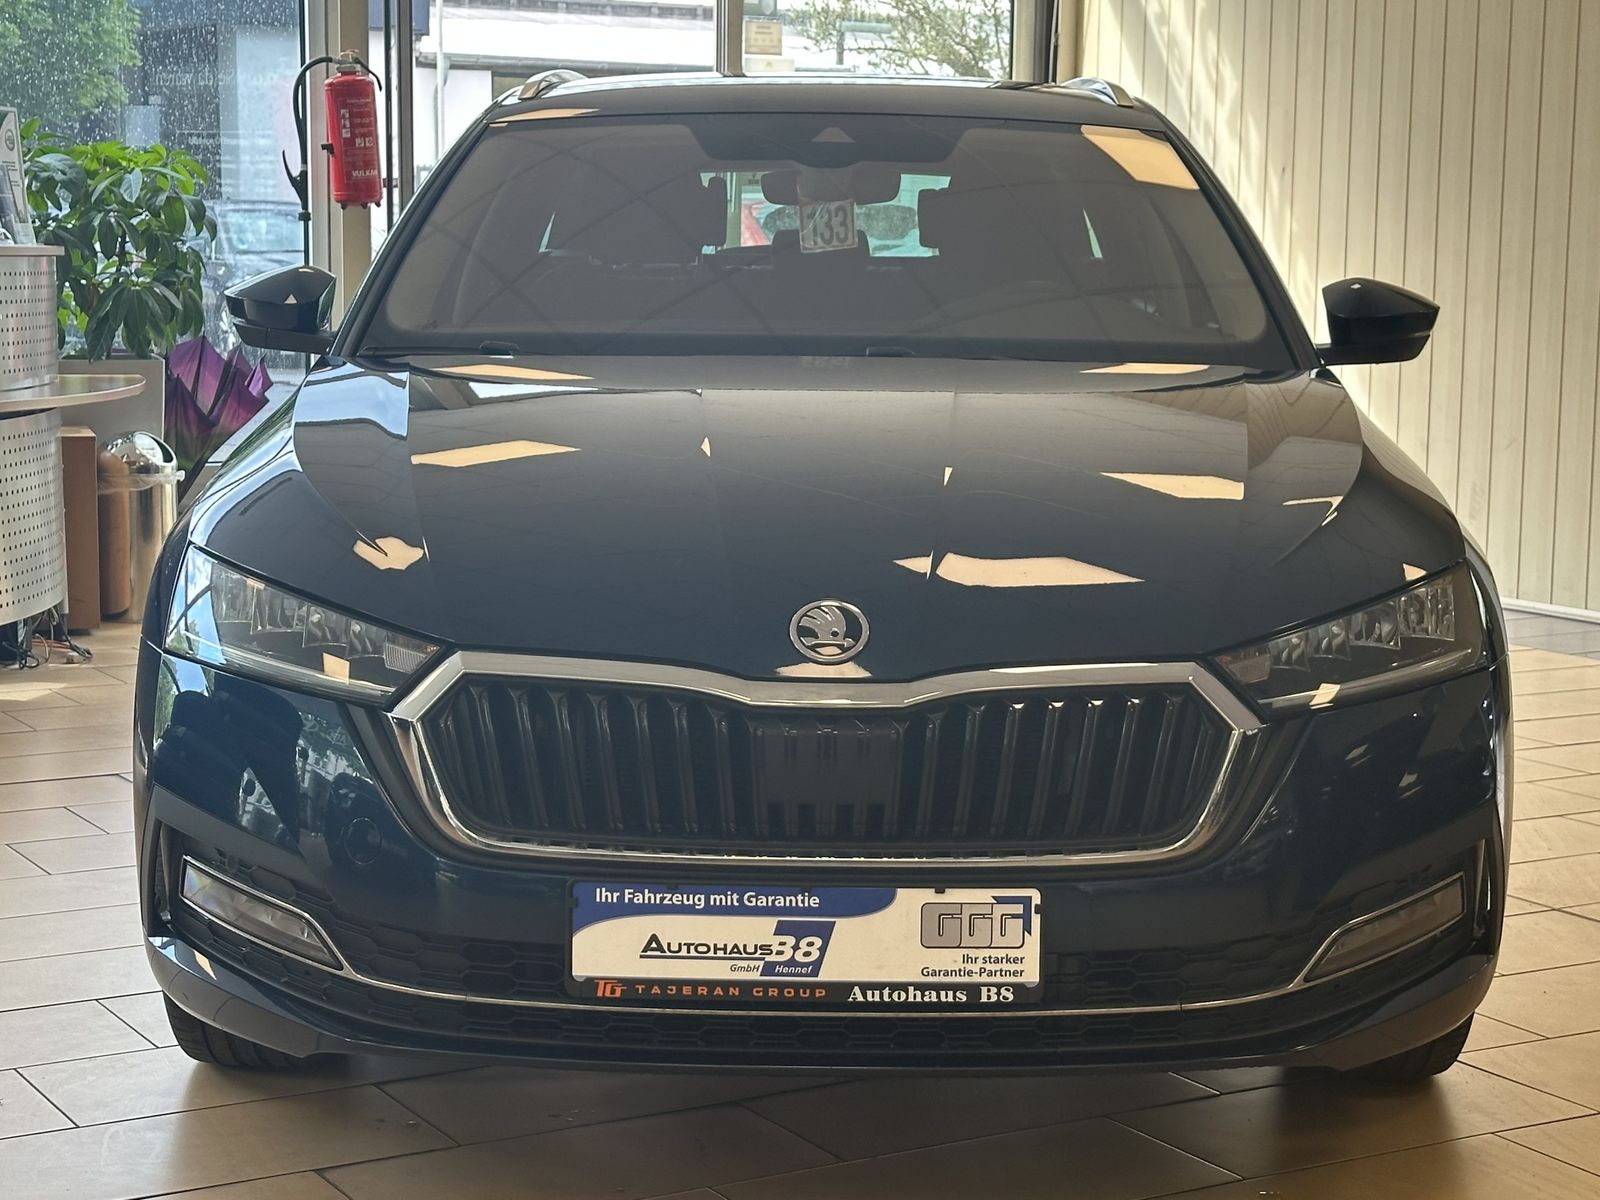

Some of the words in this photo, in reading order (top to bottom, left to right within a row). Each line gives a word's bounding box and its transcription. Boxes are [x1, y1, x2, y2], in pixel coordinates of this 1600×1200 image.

[807, 205, 849, 246] 133
[595, 887, 620, 903] Ihr
[624, 888, 705, 909] Fahrzeug
[709, 891, 739, 906] mit
[743, 891, 820, 907] Garantie
[962, 953, 979, 965] Ihr
[981, 953, 1025, 965] starker
[729, 963, 760, 973] GmbH
[774, 964, 813, 974] Hennef
[920, 966, 1025, 978] Garantie-Partner
[635, 984, 740, 997] TAJERAN
[752, 986, 827, 998] GROUP
[847, 985, 968, 1003] Autohaus
[979, 985, 1015, 1003] B8
